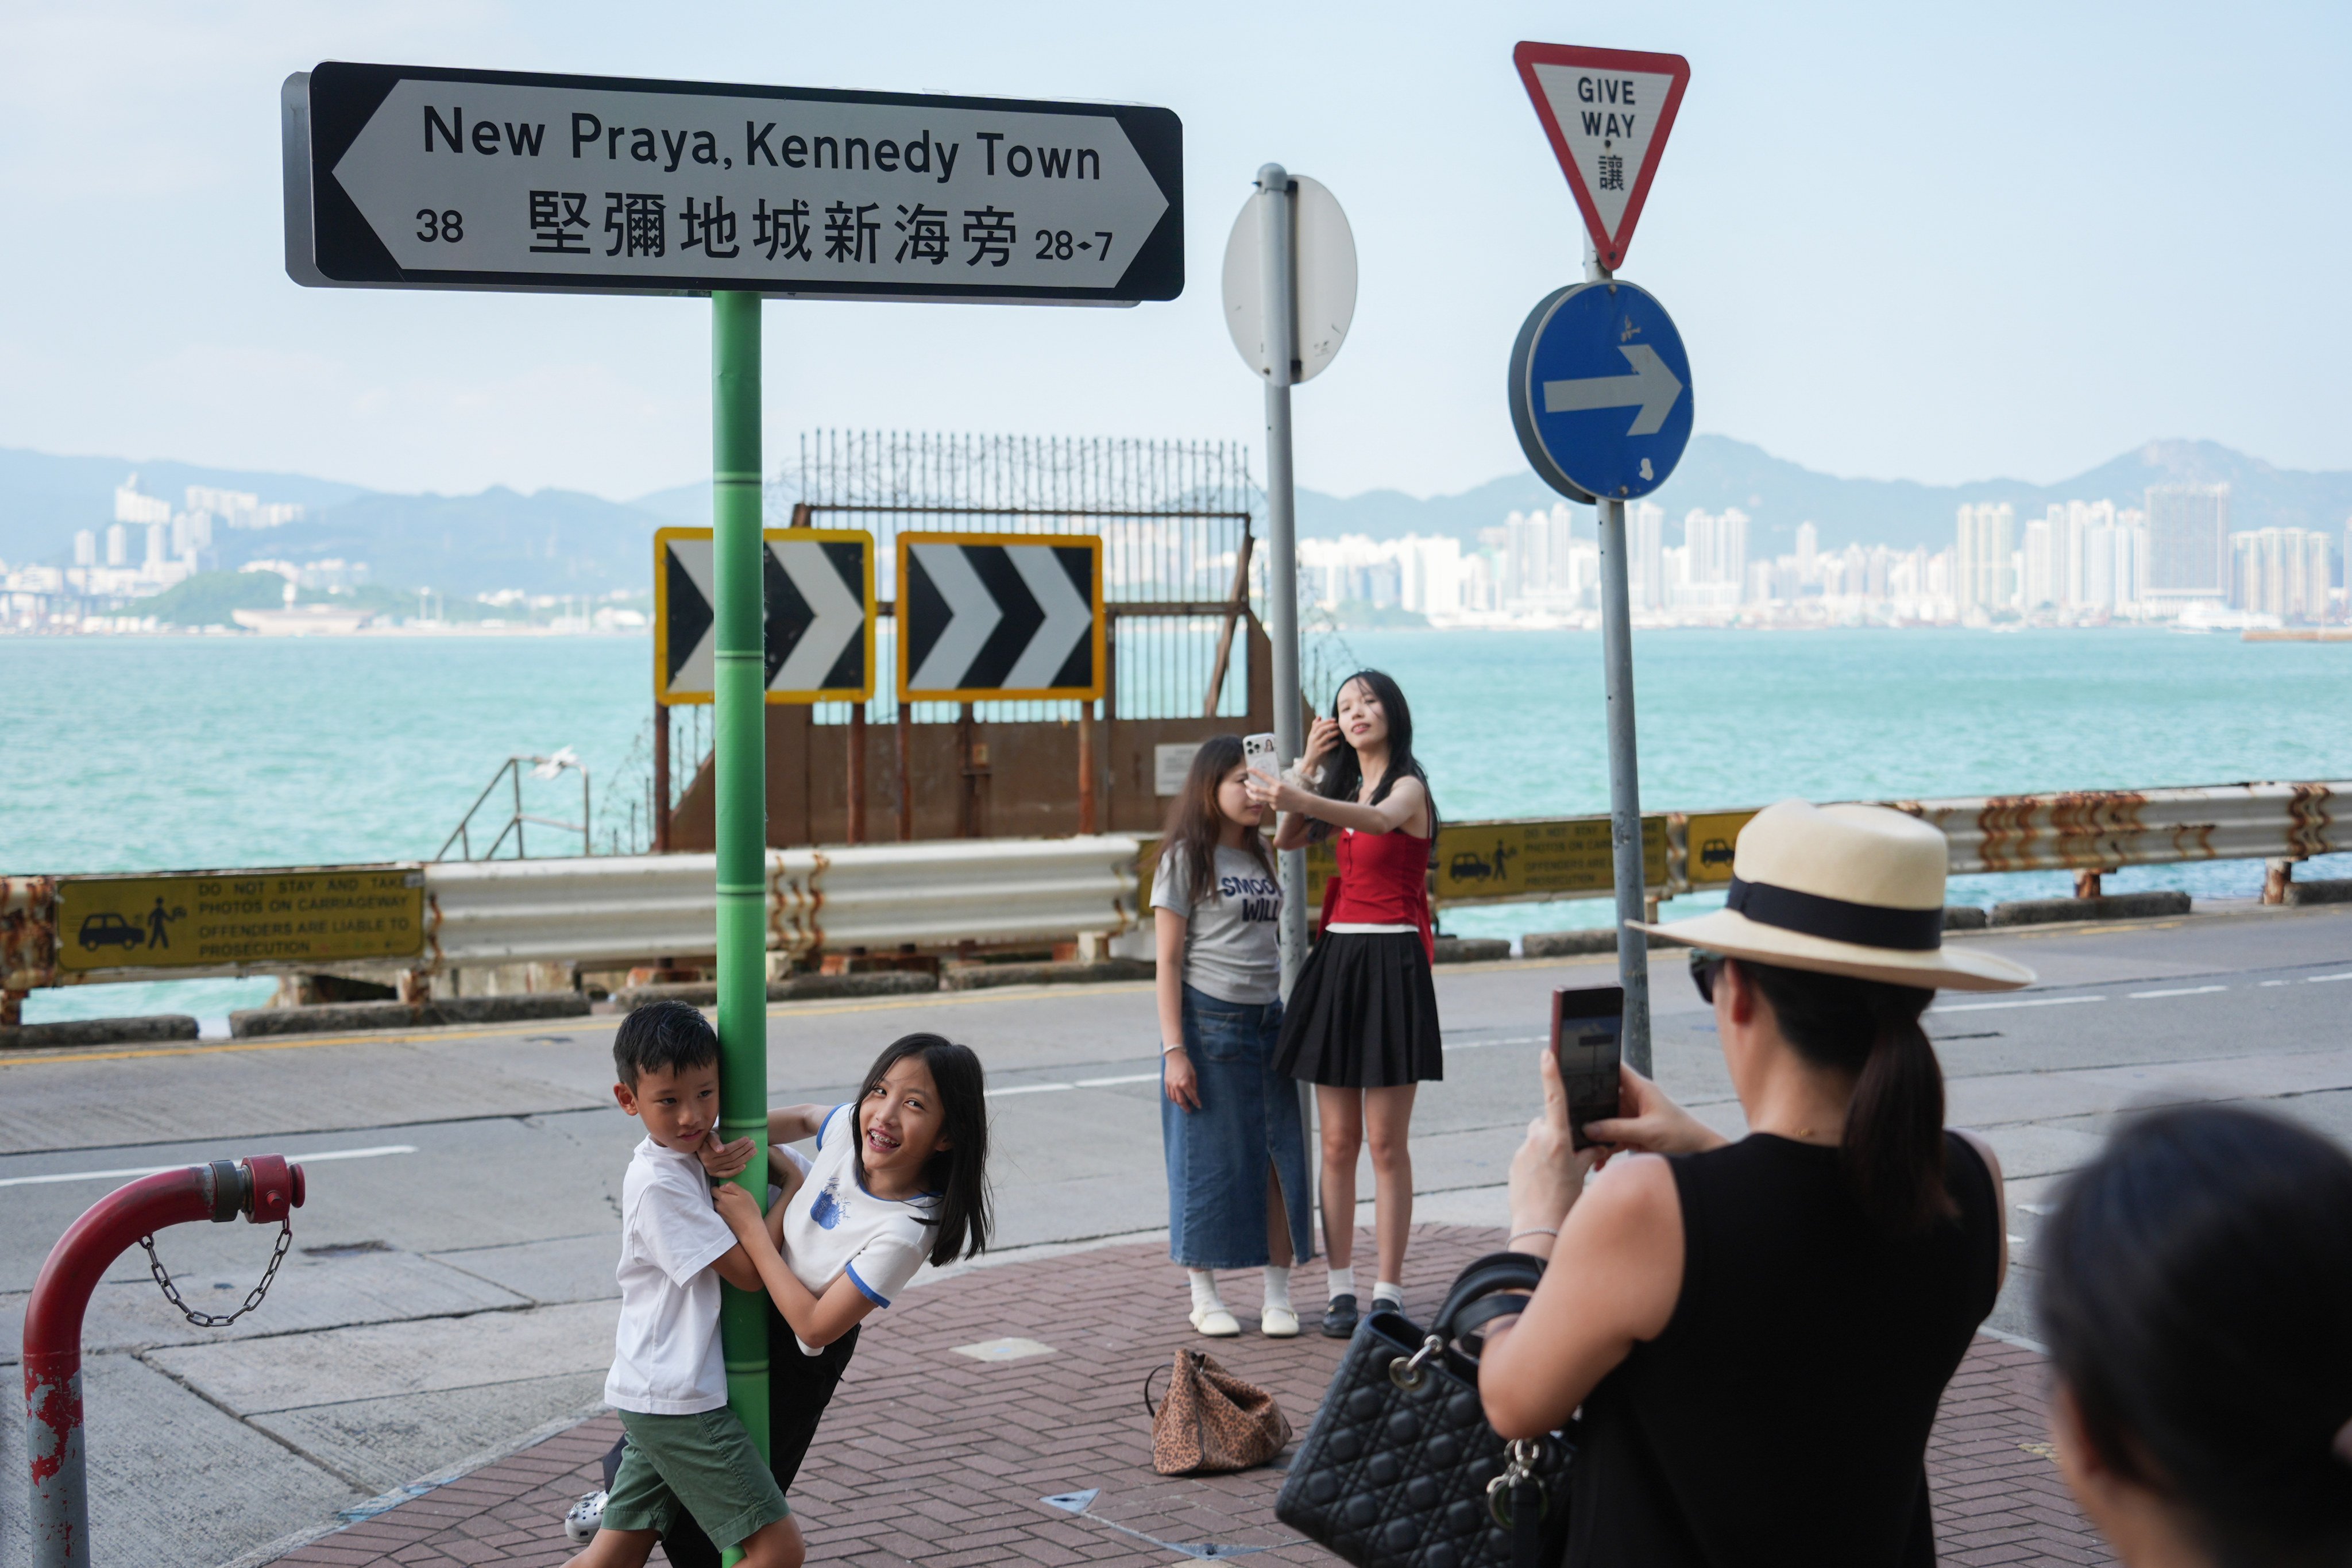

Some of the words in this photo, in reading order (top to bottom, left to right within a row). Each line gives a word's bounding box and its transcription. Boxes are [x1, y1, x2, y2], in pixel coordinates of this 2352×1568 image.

[1578, 77, 1636, 105] GIVE
[1581, 111, 1635, 138] WAY
[424, 105, 546, 157] New
[571, 112, 732, 173] Praya,
[746, 121, 959, 184] Kennedy
[976, 132, 1100, 180] Town
[1598, 155, 1625, 191] 讓
[416, 208, 464, 243] 38
[529, 190, 1016, 267] 堅彌地城新海旁
[199, 882, 222, 897] DO
[234, 881, 264, 895] NOT
[278, 879, 316, 894] STAY
[327, 877, 360, 892] AND
[199, 899, 263, 915] PHOTOS
[268, 899, 292, 913] ON
[199, 922, 292, 940] OFFENDERS
[296, 920, 329, 934] ARE
[390, 916, 410, 931] TO
[199, 940, 311, 957] PROSECUTION
